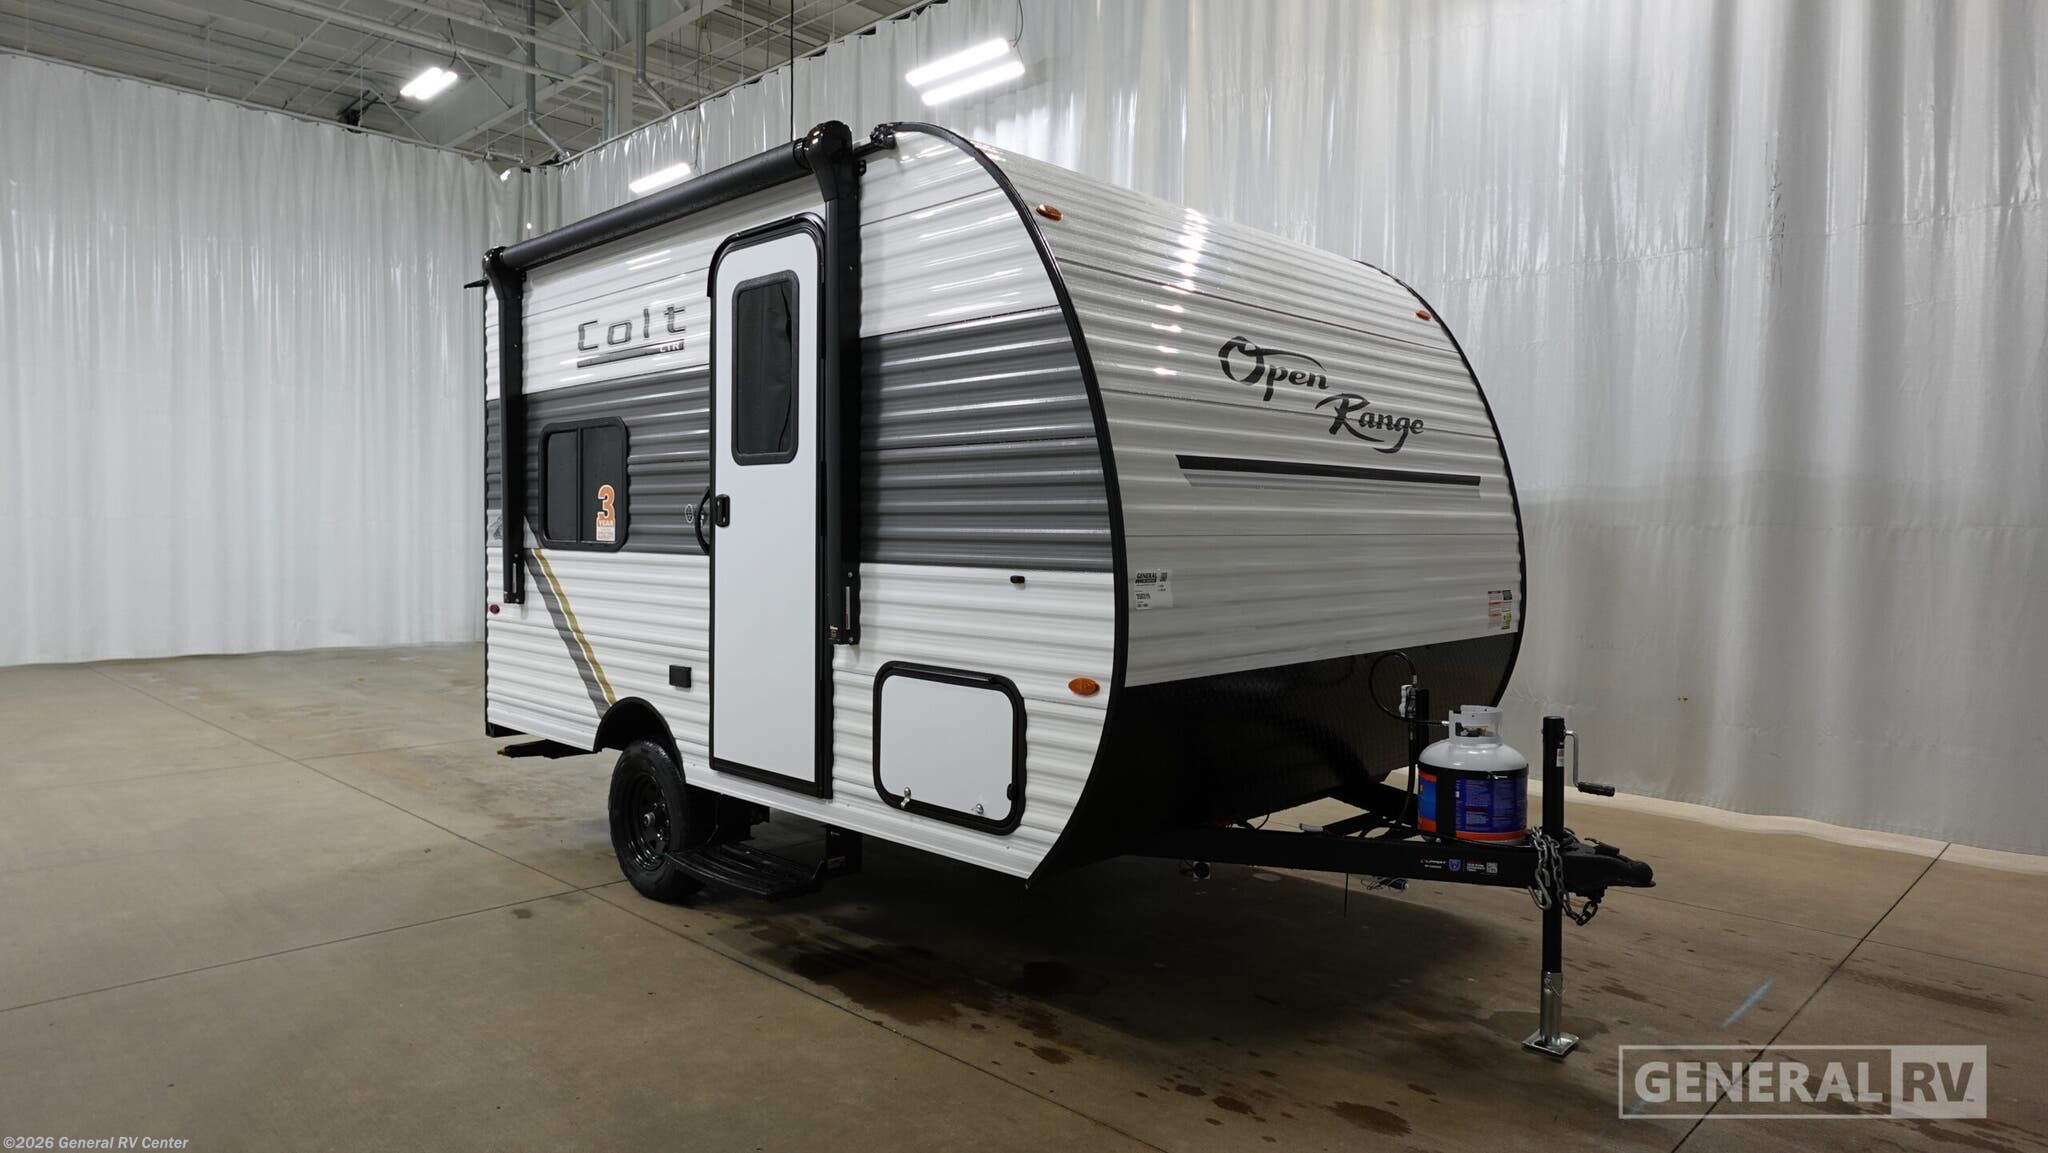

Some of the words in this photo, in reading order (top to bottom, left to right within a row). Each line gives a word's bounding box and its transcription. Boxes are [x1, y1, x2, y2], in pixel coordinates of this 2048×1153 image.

[577, 306, 685, 352] Colt
[1218, 336, 1329, 402] Open
[1314, 393, 1424, 454] Range
[597, 484, 615, 521] 3
